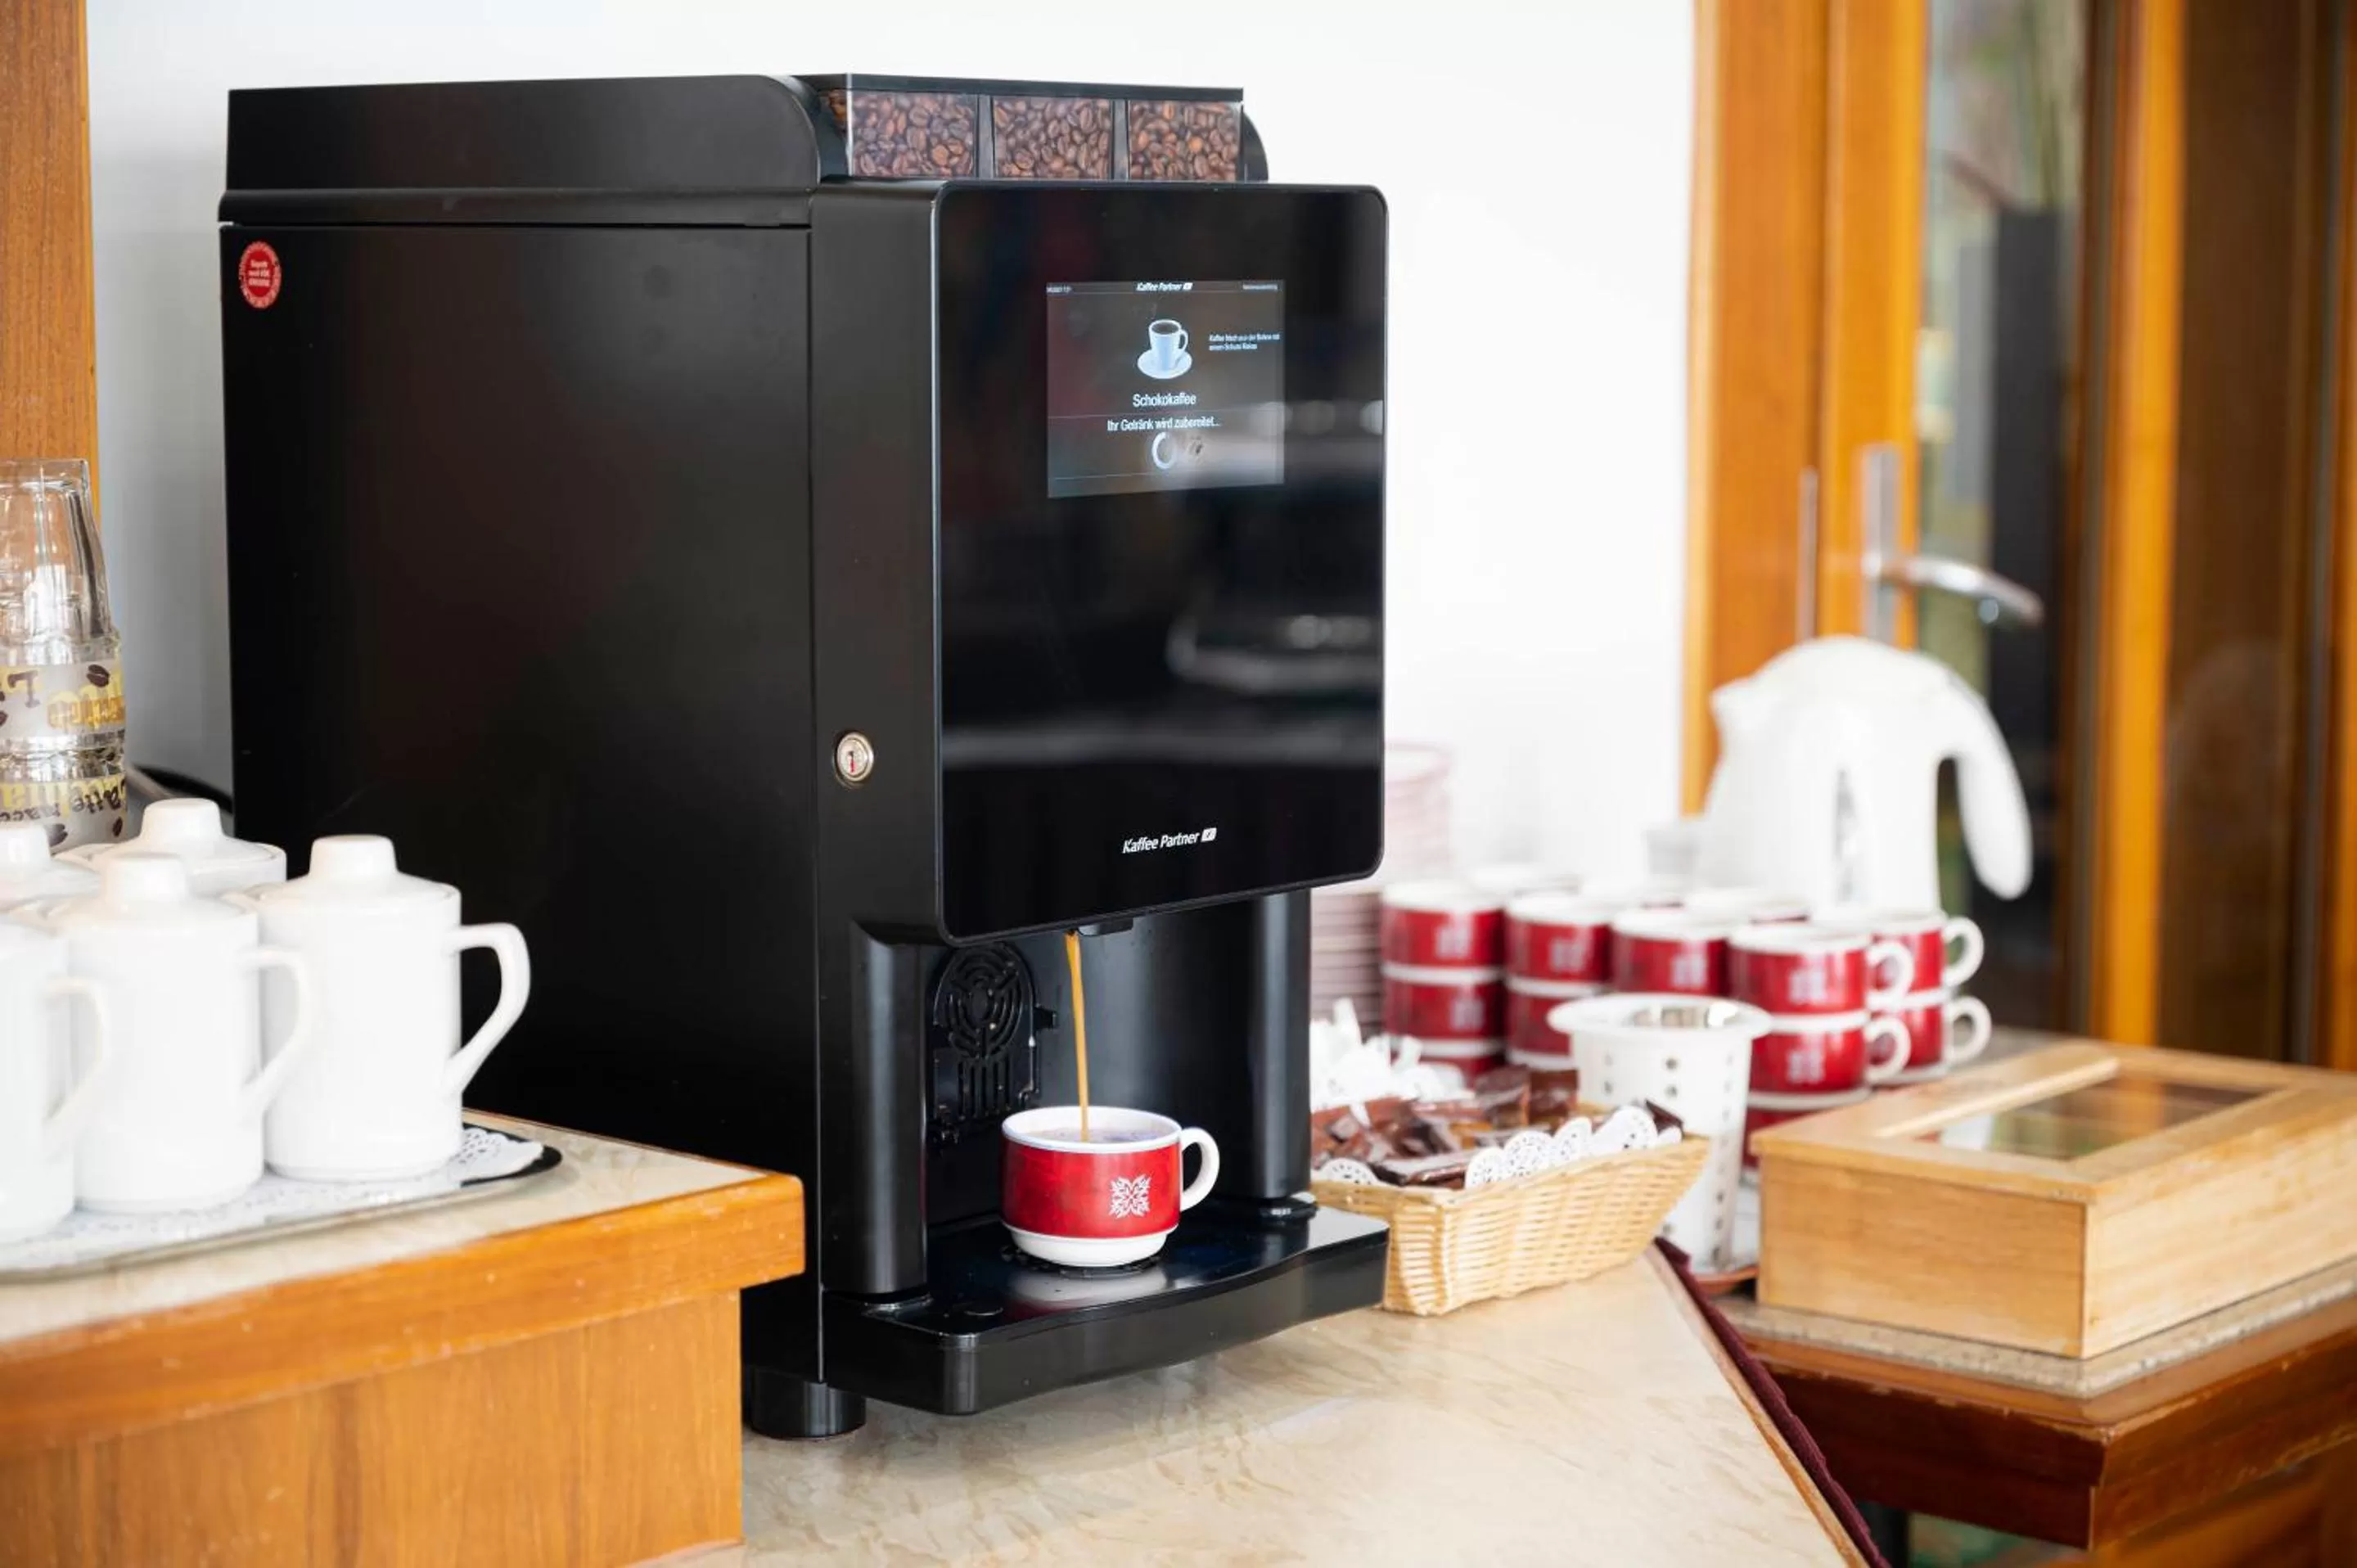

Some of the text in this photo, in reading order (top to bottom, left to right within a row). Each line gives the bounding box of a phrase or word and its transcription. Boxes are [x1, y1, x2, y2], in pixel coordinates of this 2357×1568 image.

[1133, 392, 1197, 407] Schokokaffee
[1107, 420, 1119, 431] Ihr
[1120, 418, 1154, 431] Getränk
[1155, 417, 1174, 430] wird
[1122, 832, 1200, 854] Kaffee Partner
